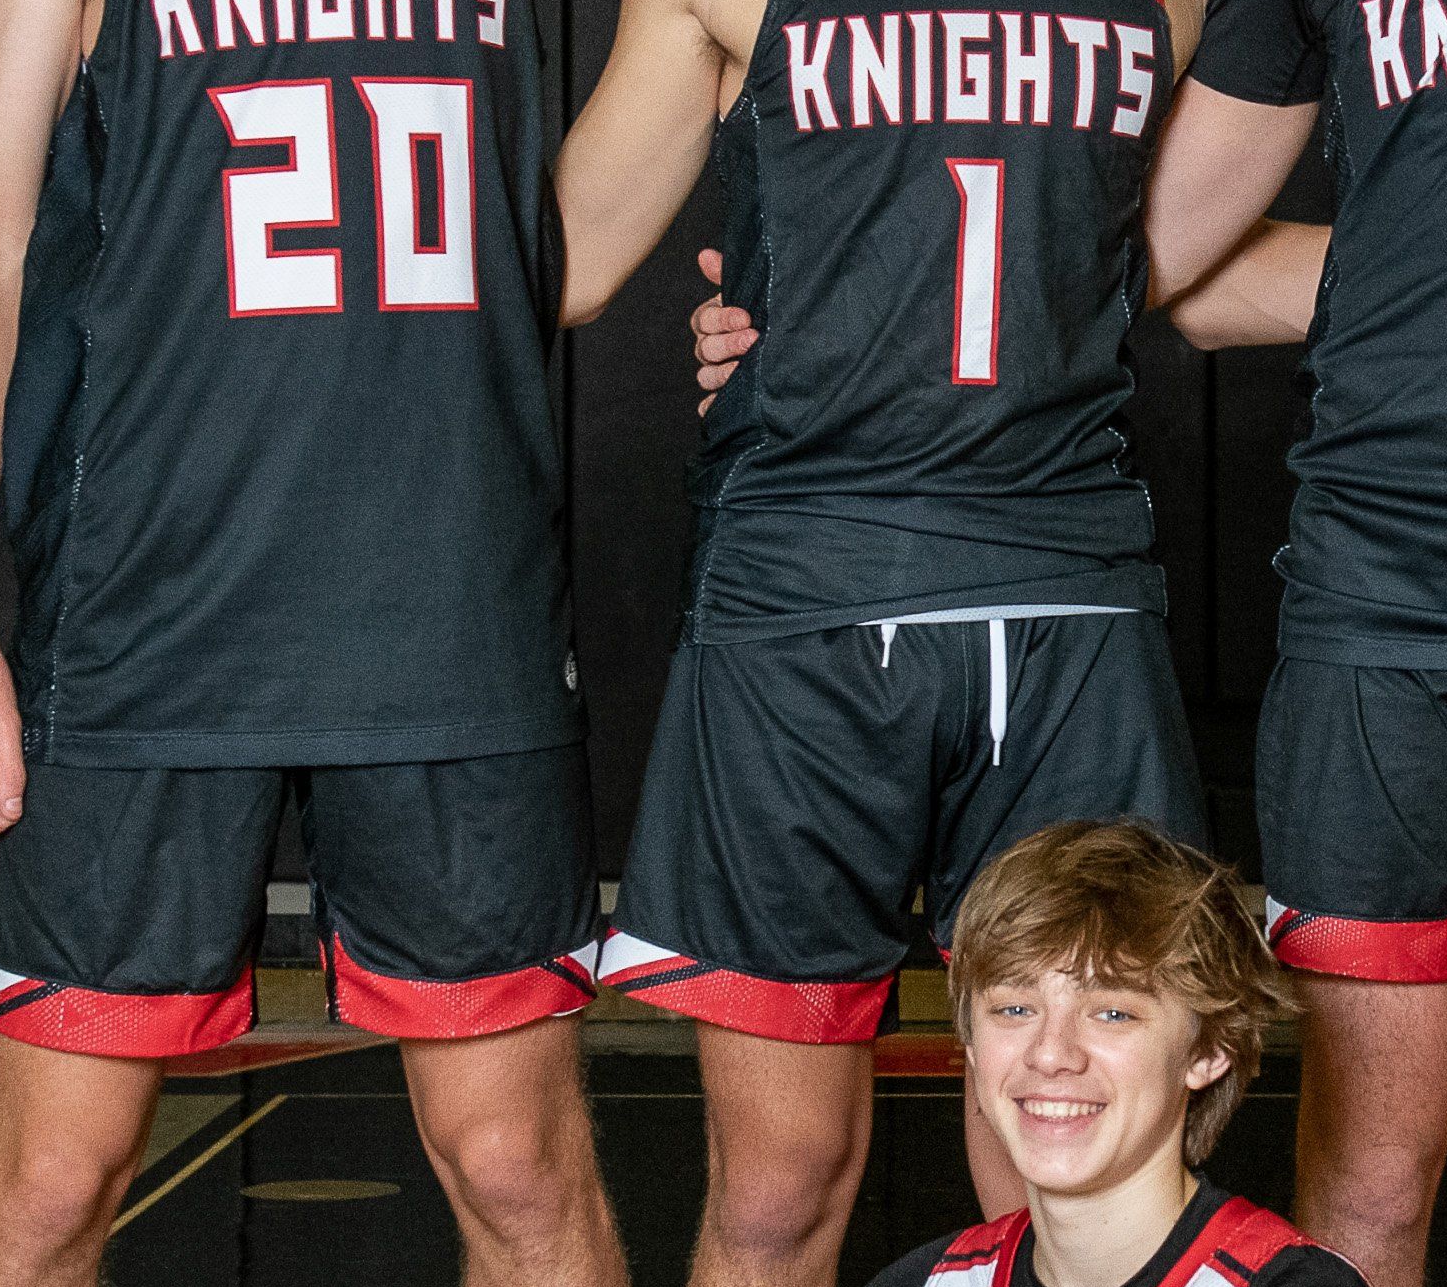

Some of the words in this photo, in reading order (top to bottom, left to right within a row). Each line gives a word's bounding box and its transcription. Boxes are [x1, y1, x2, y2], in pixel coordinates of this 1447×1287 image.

[782, 11, 1155, 138] KNIGHTS
[206, 76, 479, 318] 20
[944, 157, 1005, 386] 1
